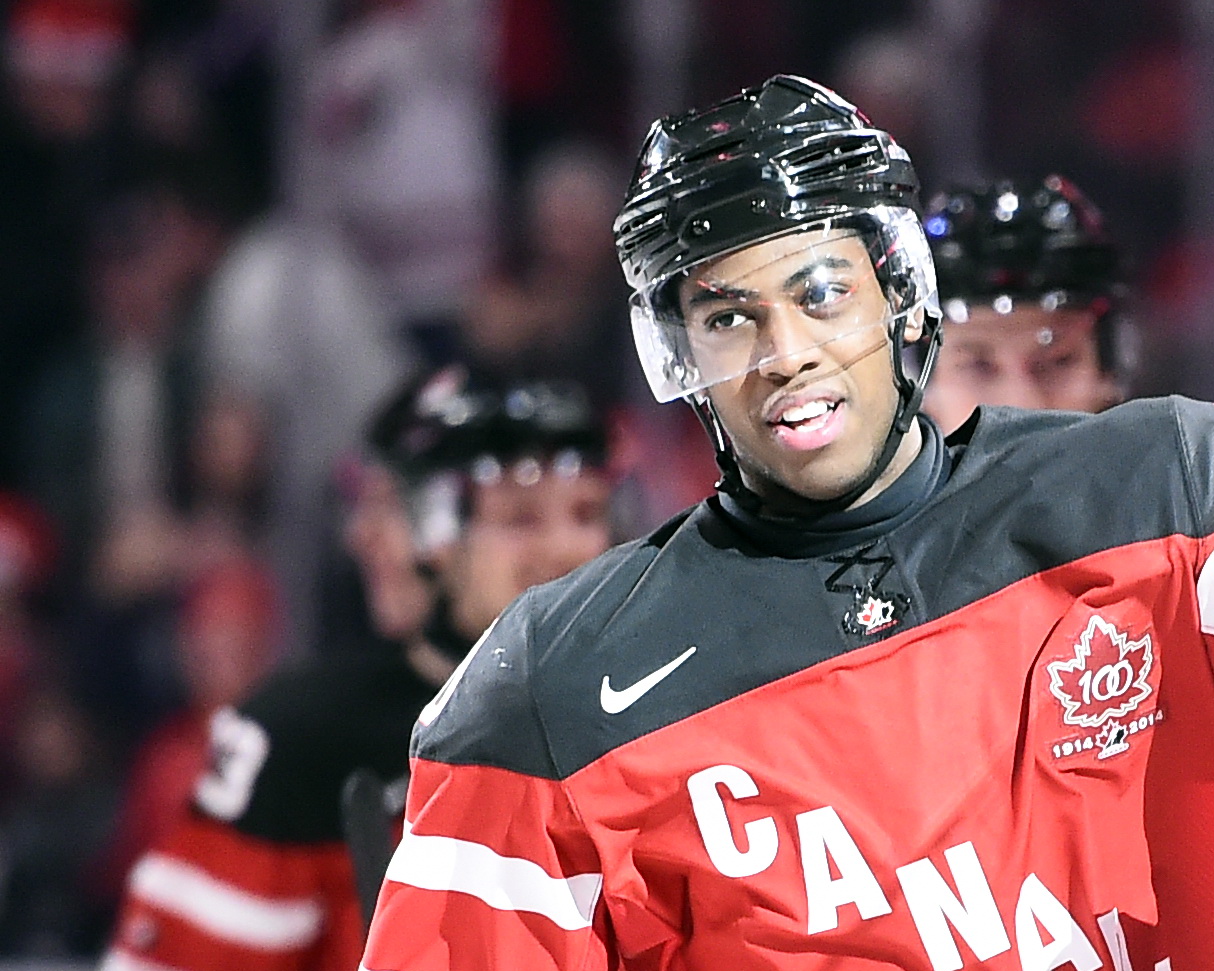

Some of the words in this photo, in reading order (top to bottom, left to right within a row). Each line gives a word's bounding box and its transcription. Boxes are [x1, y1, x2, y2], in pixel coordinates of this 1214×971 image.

[1078, 659, 1134, 705] 100
[1052, 736, 1094, 759] 1914
[1128, 709, 1164, 735] 2014
